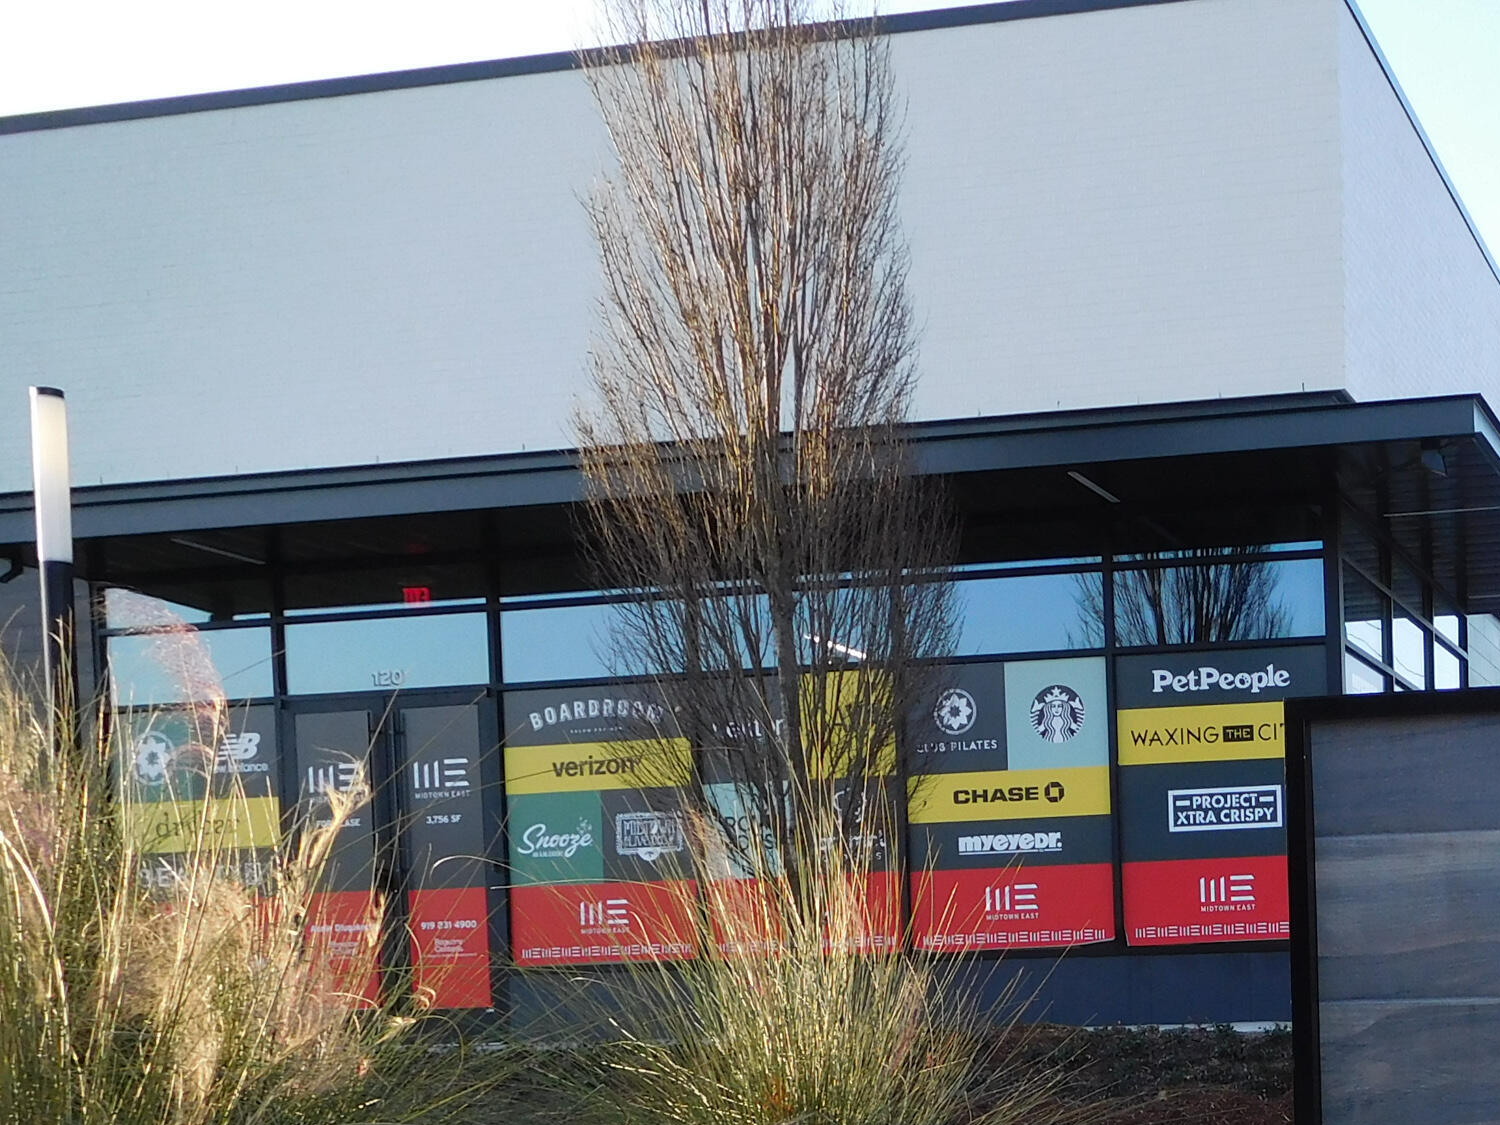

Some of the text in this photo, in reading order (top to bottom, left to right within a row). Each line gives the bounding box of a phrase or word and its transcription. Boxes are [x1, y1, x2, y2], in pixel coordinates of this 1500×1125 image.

[1152, 664, 1290, 693] PetPeople
[1131, 726, 1219, 746] WAXING
[1225, 727, 1252, 740] THE
[950, 740, 998, 752] PILATES
[552, 755, 635, 777] verizon
[953, 786, 1039, 804] CHASE
[1192, 793, 1258, 809] PROJECT
[1176, 807, 1274, 825] XTRA CRISPY
[517, 823, 593, 858] Snooze
